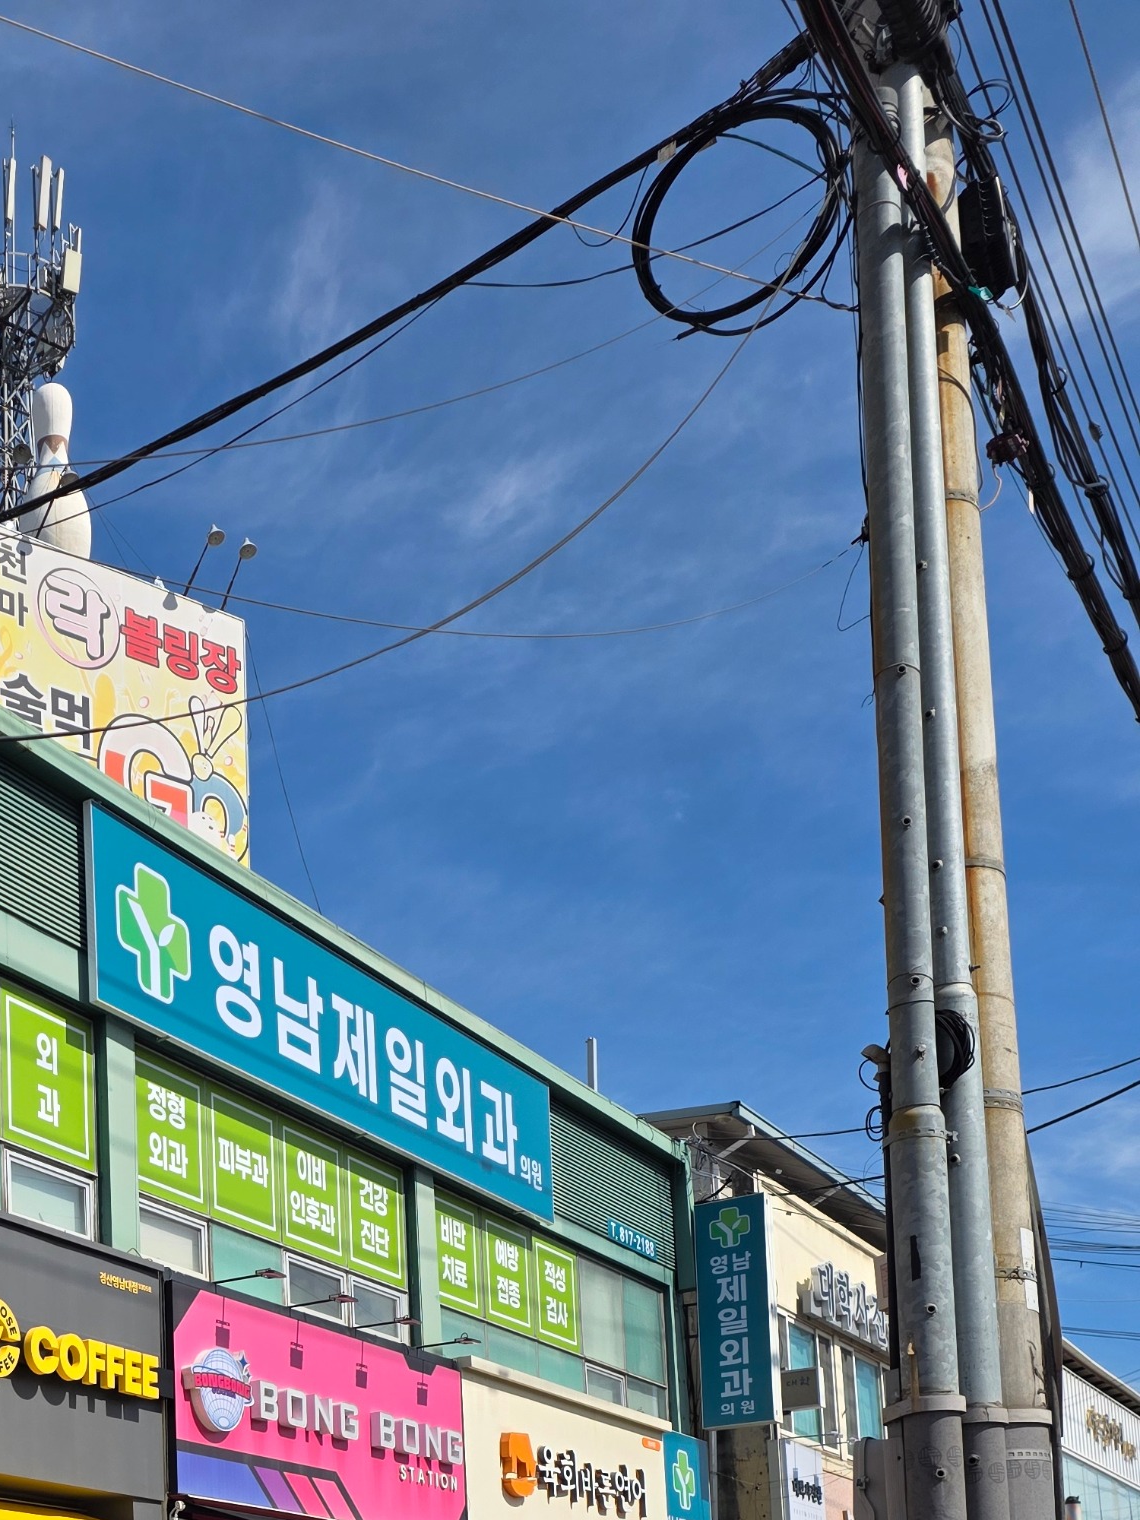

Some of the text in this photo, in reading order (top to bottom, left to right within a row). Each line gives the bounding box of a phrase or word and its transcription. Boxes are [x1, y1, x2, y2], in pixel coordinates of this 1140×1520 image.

[120, 607, 242, 695] 볼링장
[208, 923, 544, 1191] 영남제일외과 의원
[36, 1032, 61, 1128] 외과
[147, 1081, 187, 1131] 정형
[148, 1131, 189, 1180] 외과
[217, 1136, 269, 1189] 피부과
[296, 1149, 327, 1192] 이비
[289, 1190, 336, 1237] 인후과
[358, 1177, 389, 1217] 건강
[359, 1218, 390, 1259] 진단
[440, 1214, 467, 1252] 비만
[441, 1254, 469, 1289] 치료
[494, 1237, 520, 1273] 예방
[709, 1250, 752, 1275] 영남
[496, 1274, 521, 1309] 접종
[544, 1259, 567, 1294] 적성
[545, 1295, 569, 1329] 검사
[816, 1261, 890, 1348] 대학사진
[24, 1325, 160, 1400] COFFEE
[251, 1379, 464, 1466] BONG BONG
[720, 1399, 756, 1417] 의원
[399, 1464, 458, 1492] STATION
